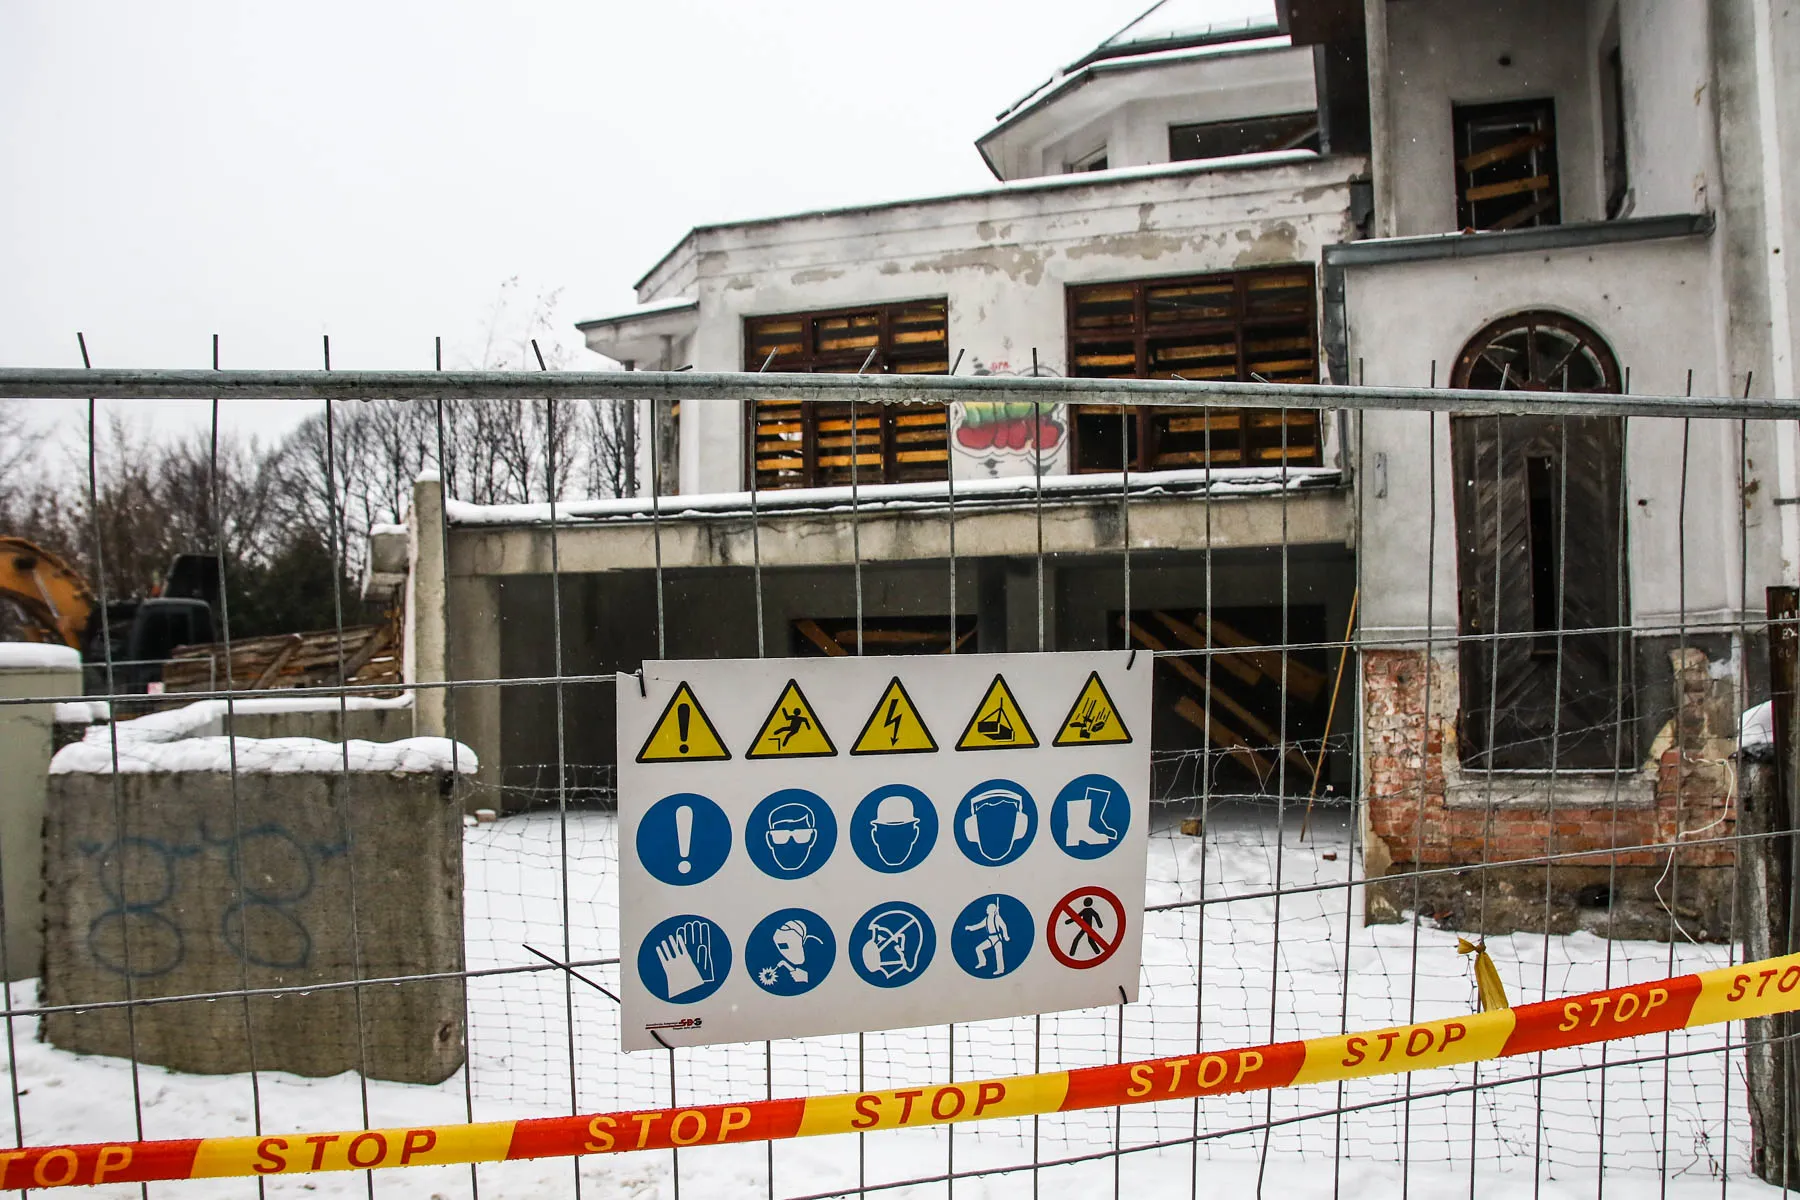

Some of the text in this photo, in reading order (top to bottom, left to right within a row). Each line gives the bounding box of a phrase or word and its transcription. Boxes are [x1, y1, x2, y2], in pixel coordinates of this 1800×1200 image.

[0, 965, 1800, 1189] TOP STOP STOP STOP STOP STOP STOP STO
